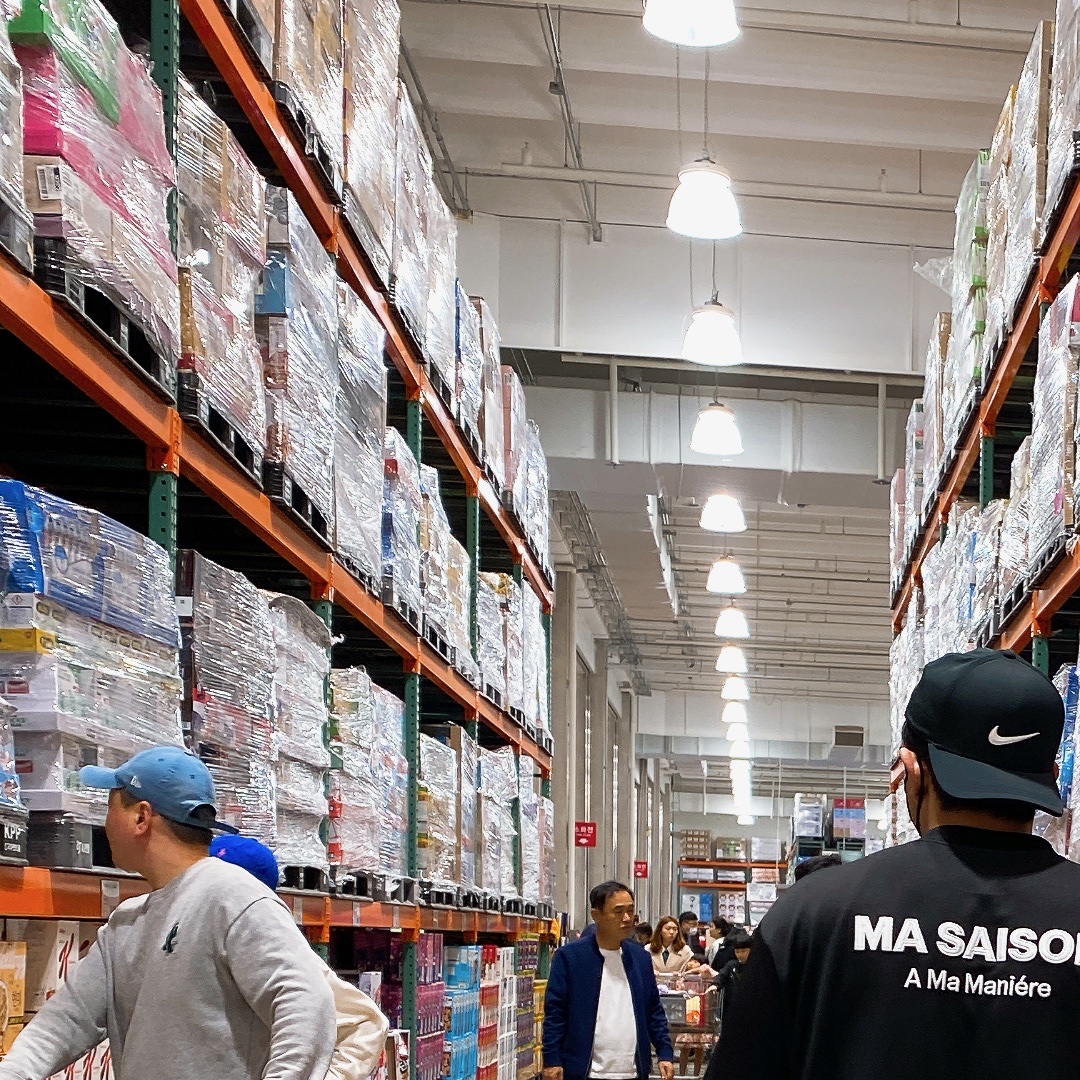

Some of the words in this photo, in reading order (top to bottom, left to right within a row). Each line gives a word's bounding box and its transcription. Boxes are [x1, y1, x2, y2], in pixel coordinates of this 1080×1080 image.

[853, 915, 928, 954] MA
[904, 968, 922, 988] A
[927, 969, 960, 992] Ma
[964, 973, 1051, 998] Maniére
